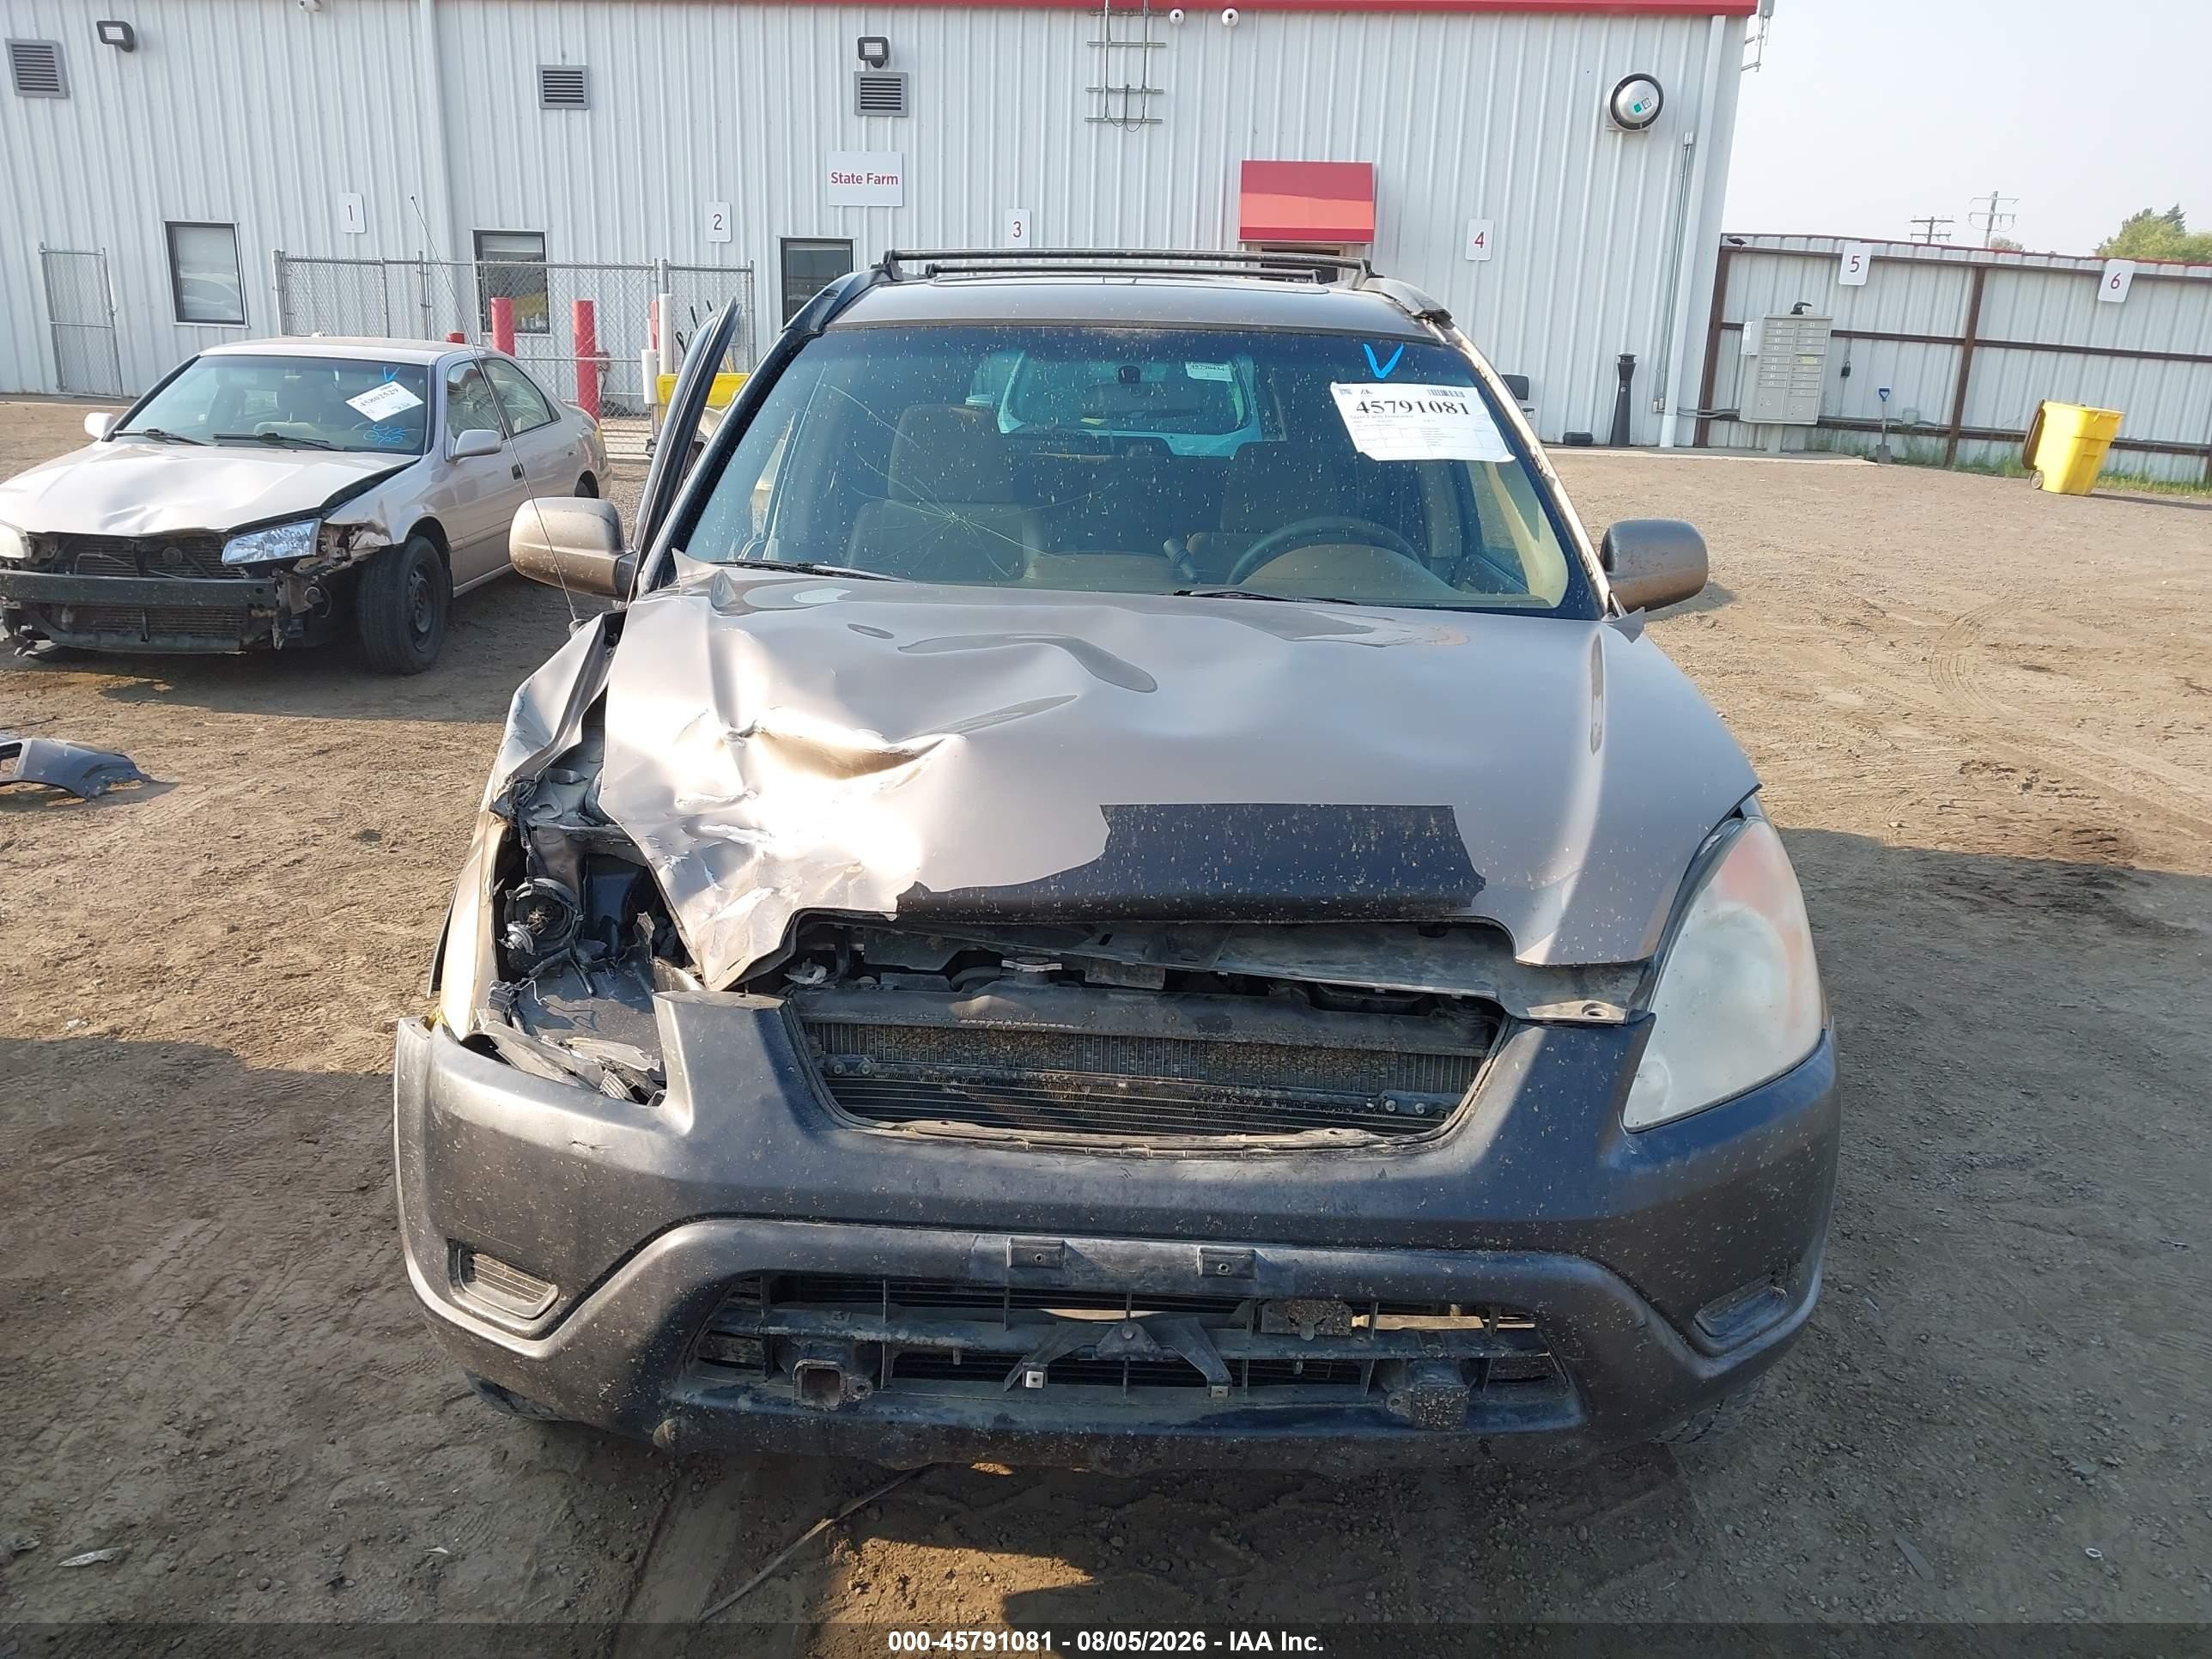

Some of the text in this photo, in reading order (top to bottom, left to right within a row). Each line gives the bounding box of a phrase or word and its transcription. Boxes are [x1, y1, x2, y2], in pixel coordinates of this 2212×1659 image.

[830, 172, 899, 185] State Farm
[348, 204, 354, 222] 1
[713, 213, 723, 231] 2
[1012, 220, 1022, 238] 3
[1474, 231, 1485, 249] 4
[1849, 255, 1862, 273] 5
[2110, 271, 2121, 289] 6
[1356, 399, 1471, 416] 45791081
